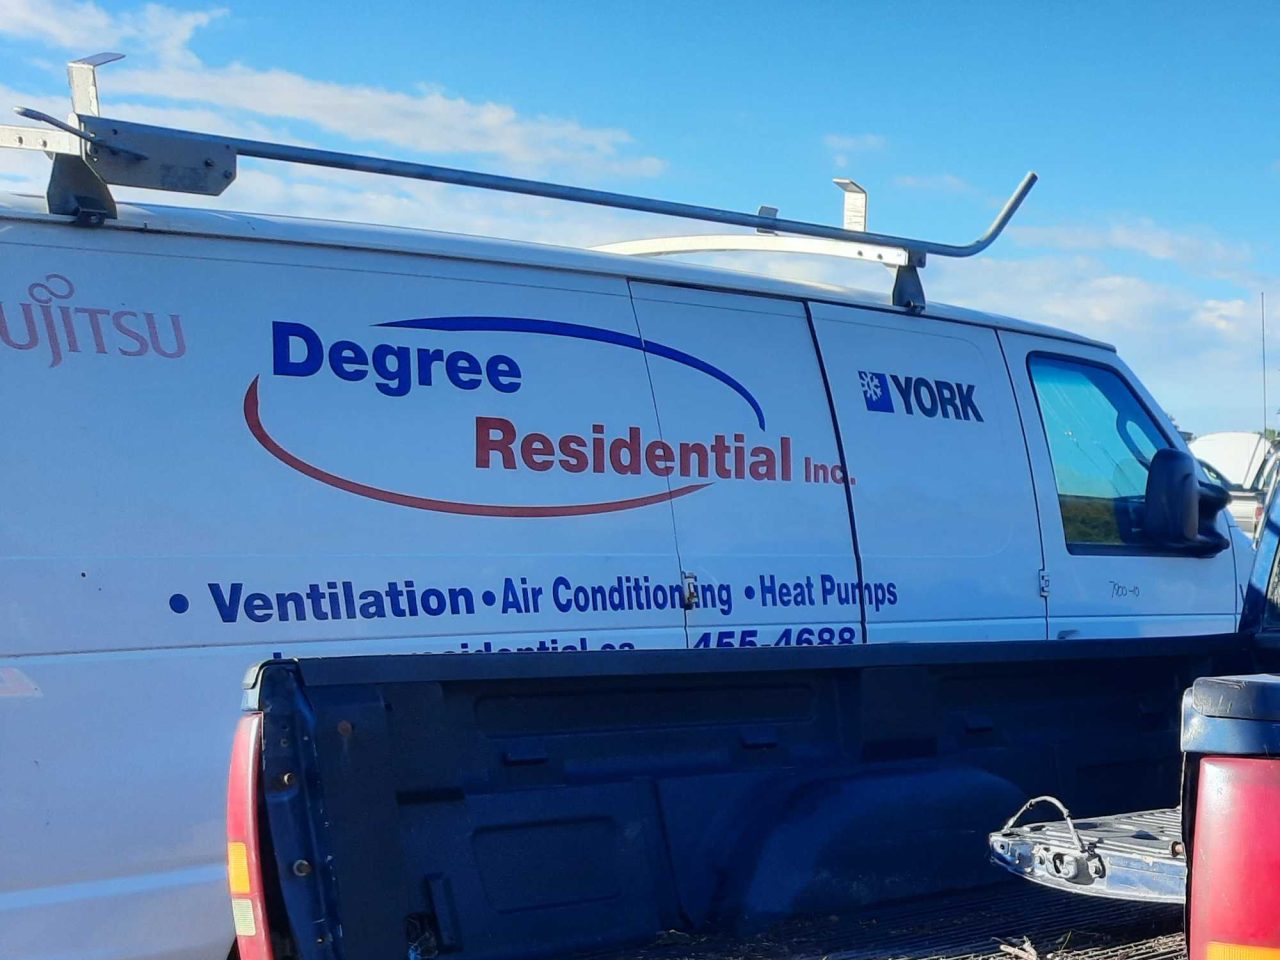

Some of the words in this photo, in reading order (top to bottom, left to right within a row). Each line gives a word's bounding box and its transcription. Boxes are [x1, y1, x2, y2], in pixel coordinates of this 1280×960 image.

[271, 320, 522, 398] Degree
[890, 374, 984, 422] YORK
[475, 416, 792, 482] Residential
[804, 457, 856, 485] Inc.
[207, 580, 475, 623] Ventilation
[501, 577, 543, 614] Air
[759, 575, 814, 607] Heat
[820, 574, 898, 612] Pumps
